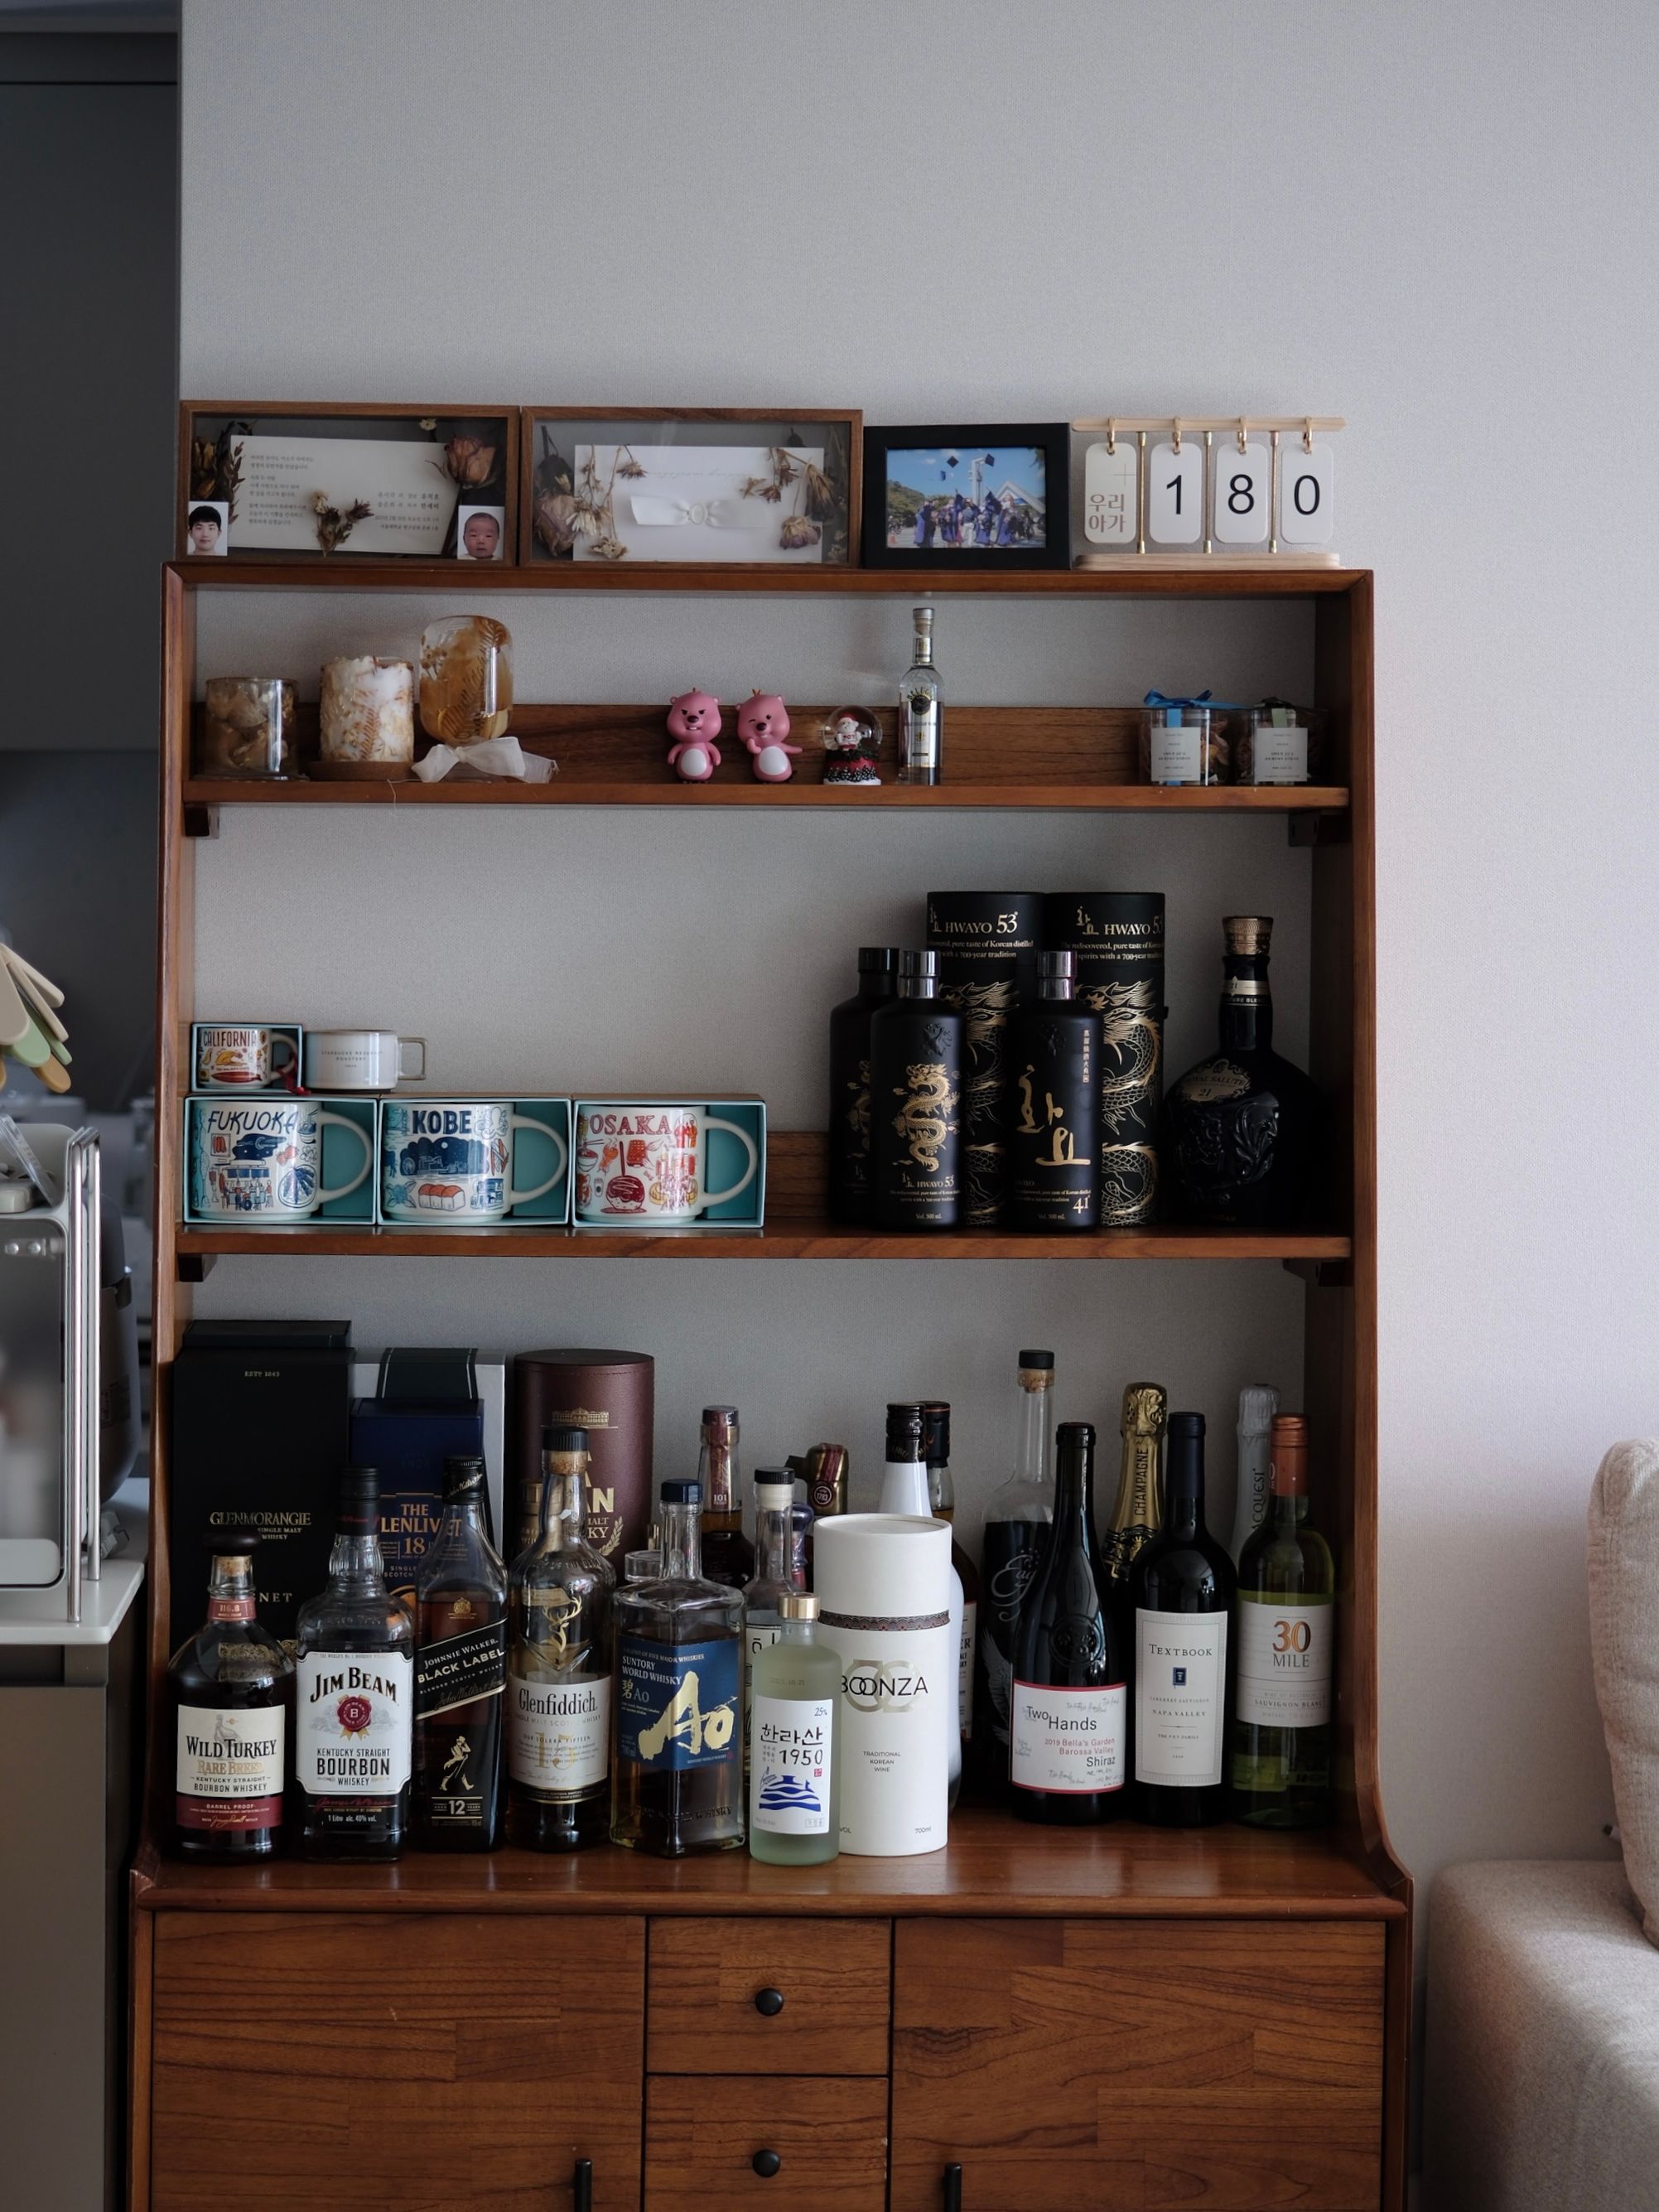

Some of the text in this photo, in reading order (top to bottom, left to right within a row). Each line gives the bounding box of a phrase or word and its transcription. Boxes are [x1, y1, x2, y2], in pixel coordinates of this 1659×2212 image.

[1166, 474, 1182, 514] 1
[1227, 473, 1255, 514] 8
[1293, 475, 1321, 515] 0
[1089, 494, 1125, 512] 우리
[1088, 514, 1126, 532] 아가
[945, 922, 992, 934] HWAYO
[1103, 924, 1150, 935] HWAYO
[203, 1031, 257, 1047] CALIFORNIA
[1198, 1088, 1212, 1097] 21
[207, 1111, 299, 1135] FUKUOKA
[412, 1110, 472, 1134] KOBE
[590, 1114, 673, 1135] OSAKA
[1134, 1448, 1148, 1516] CHAMPAGNE
[713, 1494, 727, 1502] 101
[210, 1511, 312, 1525] GLENMORANGIE
[401, 1504, 429, 1516] THE
[404, 1537, 426, 1555] 18
[219, 1604, 240, 1612] 116.8
[1272, 1620, 1311, 1653] 30
[678, 1654, 705, 1663] WHISKIES
[1149, 1644, 1213, 1657] TEXTBOOK
[424, 1649, 461, 1669] JOHNNIE
[622, 1655, 656, 1671] SUNTORY
[1273, 1654, 1310, 1668] MILE
[417, 1663, 461, 1683] BLACK
[622, 1666, 682, 1685] WORLD WHISKY
[311, 1667, 397, 1703] JIM BEAM
[842, 1676, 928, 1696] BOONZA
[519, 1688, 596, 1715] Glenfiddich
[1254, 1700, 1299, 1708] SAUVIGNON
[350, 1708, 359, 1718] B
[814, 1707, 827, 1717] 25%
[1026, 1705, 1097, 1731] Two Hands
[761, 1723, 823, 1746] 한라산
[1062, 1738, 1088, 1746] Bella's
[1091, 1738, 1115, 1746] Garden
[186, 1736, 277, 1759] WILD TURKEY
[317, 1748, 390, 1757] KENTUCKY STRAIGHT
[1094, 1746, 1114, 1755] Valley
[779, 1748, 823, 1766] 1950
[1086, 1756, 1116, 1767] Shiraz
[198, 1760, 227, 1775] RARE
[317, 1758, 390, 1775] BOURBON
[194, 1783, 268, 1793] BOURBON WHISKEY
[338, 1777, 369, 1786] WHISKEY
[448, 1799, 465, 1815] 12
[914, 1825, 932, 1834] 700ml
